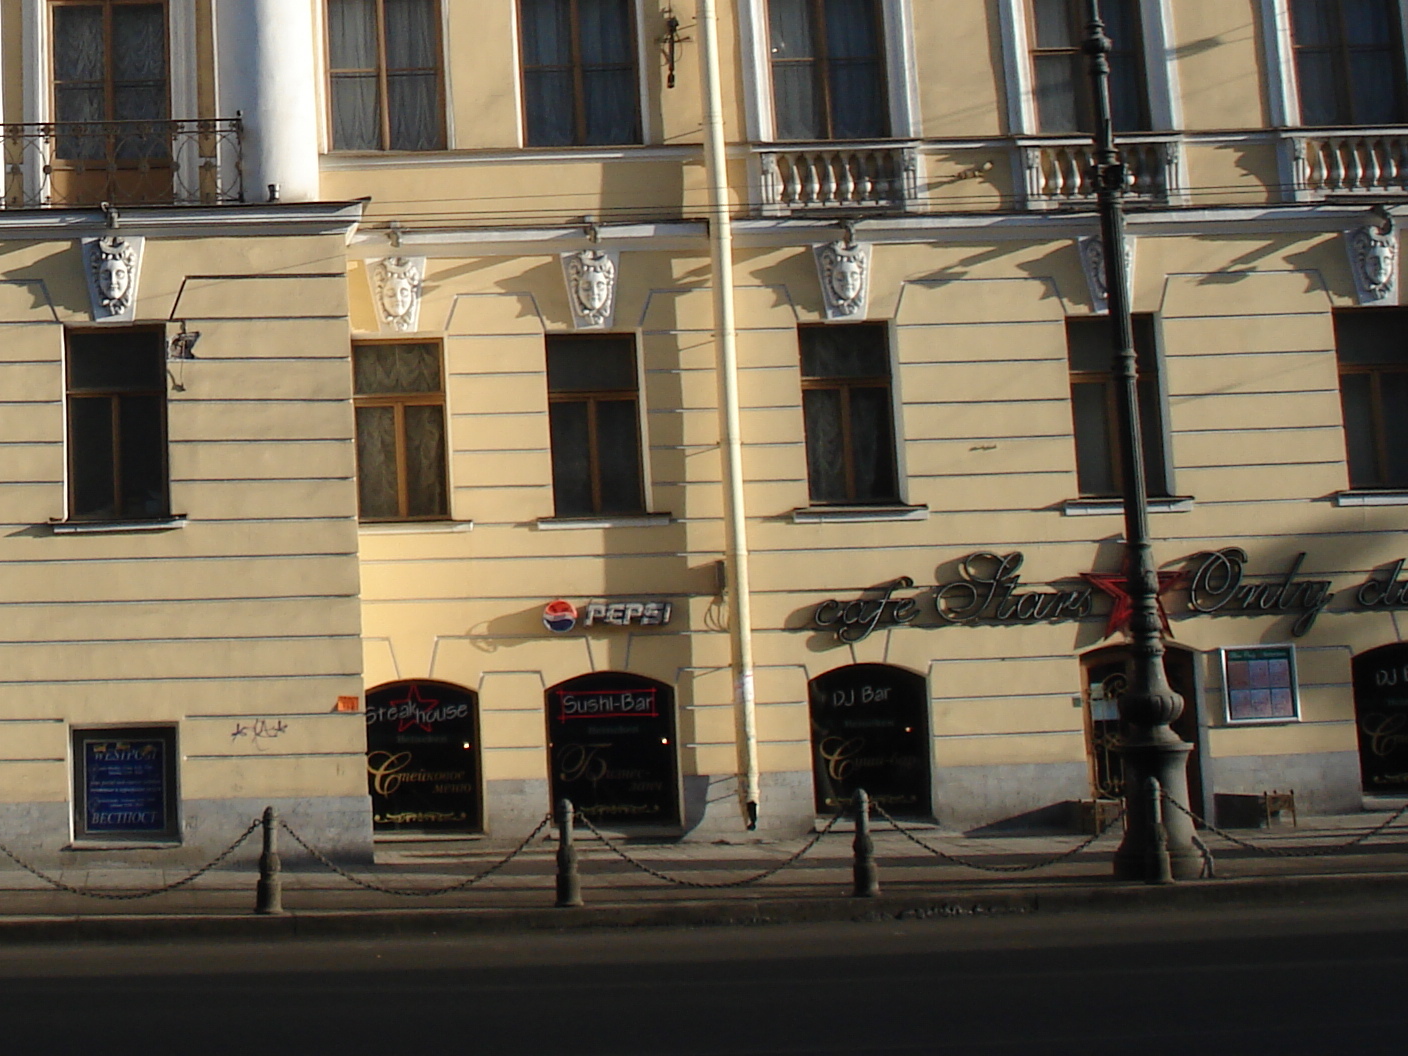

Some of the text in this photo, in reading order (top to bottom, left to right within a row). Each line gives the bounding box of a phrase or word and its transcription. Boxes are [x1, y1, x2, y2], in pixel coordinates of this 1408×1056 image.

[584, 602, 672, 627] PEPSI
[814, 551, 1095, 644] cafe Stars
[1188, 548, 1335, 638] Only
[833, 685, 892, 706] DJ Bar
